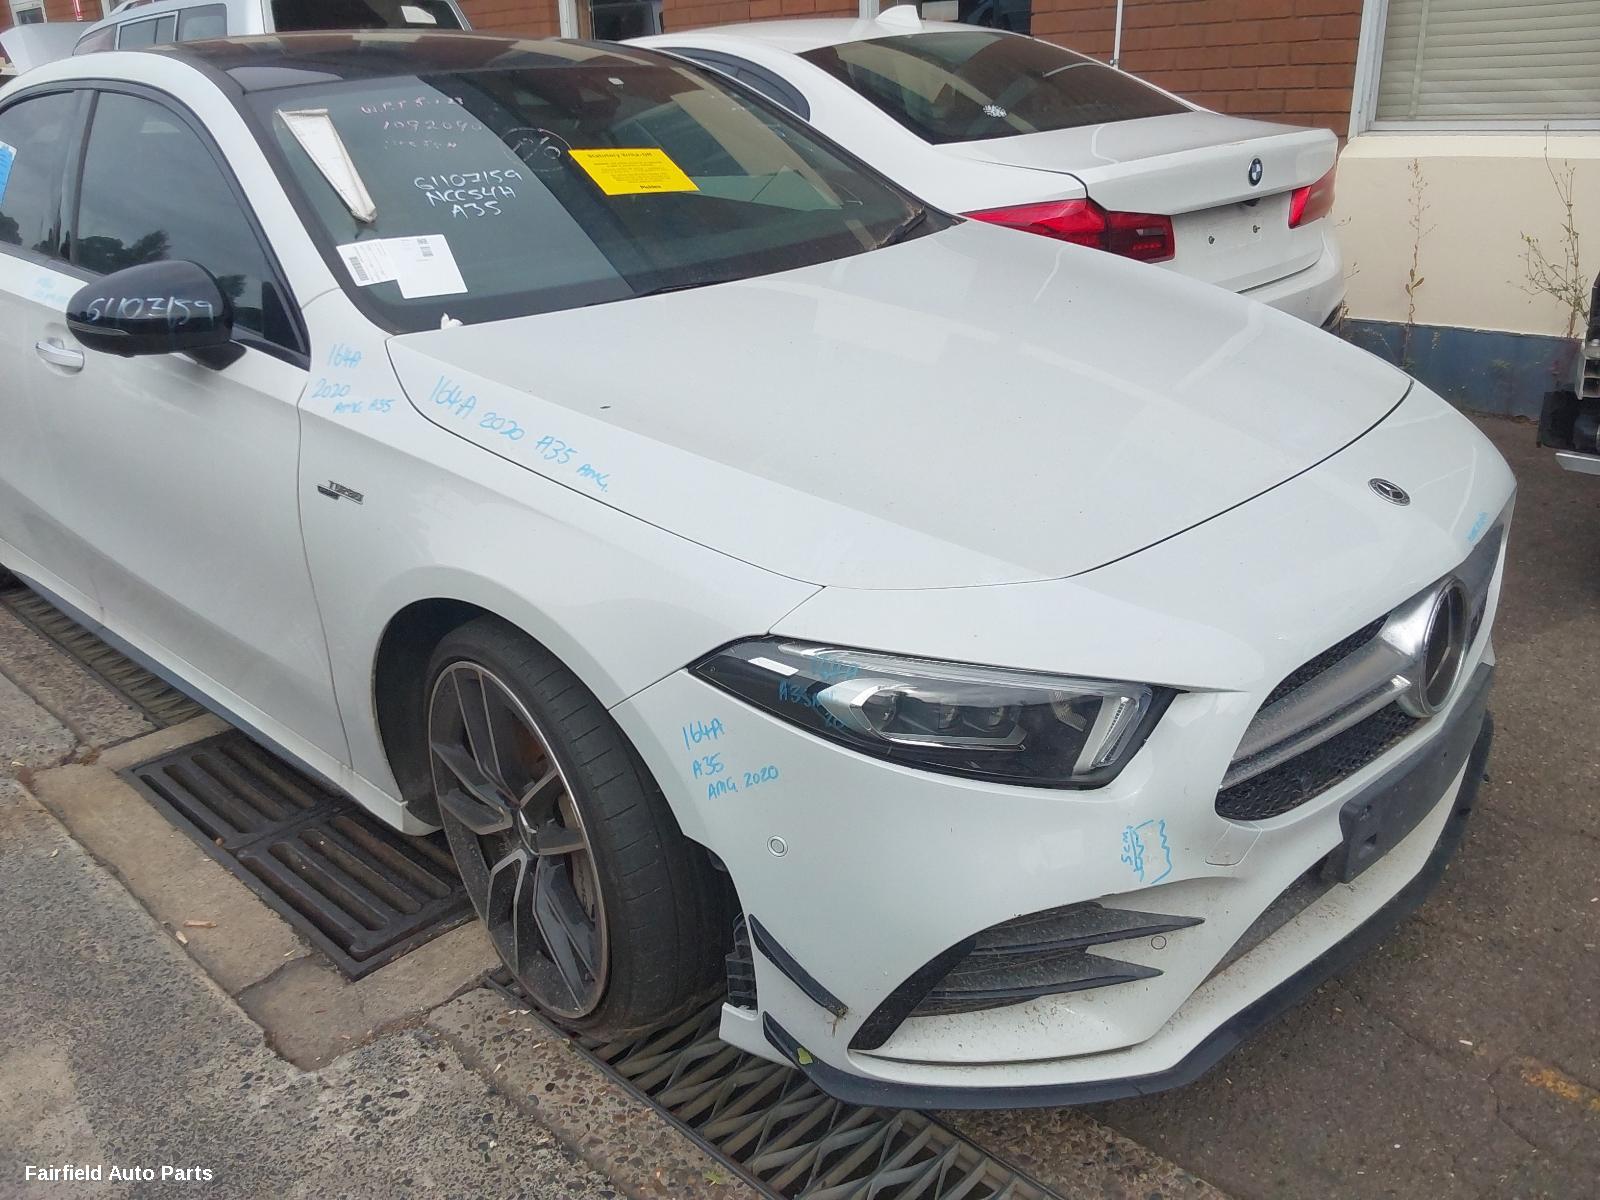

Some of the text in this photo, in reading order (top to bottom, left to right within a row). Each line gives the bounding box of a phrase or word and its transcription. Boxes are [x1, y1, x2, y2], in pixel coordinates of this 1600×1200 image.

[451, 201, 502, 219] A35
[312, 378, 351, 398] 2020
[429, 376, 477, 418] 164A
[480, 412, 525, 441] 2020
[536, 436, 578, 464] A35
[682, 717, 725, 750] 164A
[692, 752, 724, 778] A35
[744, 765, 780, 788] 2020
